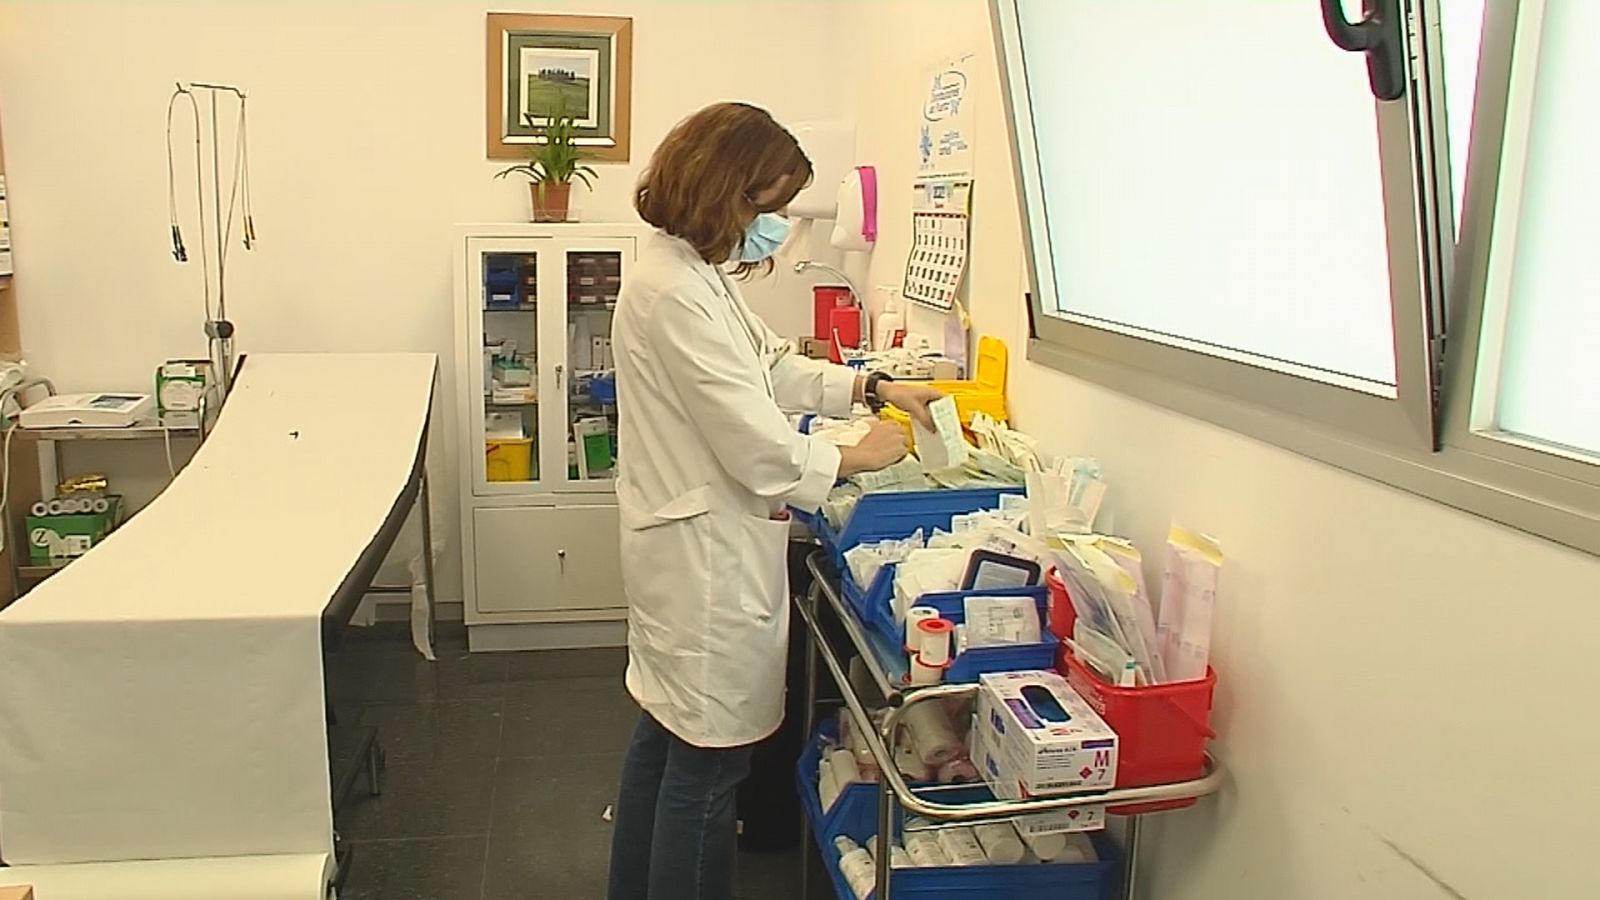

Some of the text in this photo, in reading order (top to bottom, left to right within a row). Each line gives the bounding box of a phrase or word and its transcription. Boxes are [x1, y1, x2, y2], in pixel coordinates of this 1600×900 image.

[1095, 750, 1109, 767] M
[1097, 768, 1106, 780] 7
[1087, 811, 1095, 821] 7
